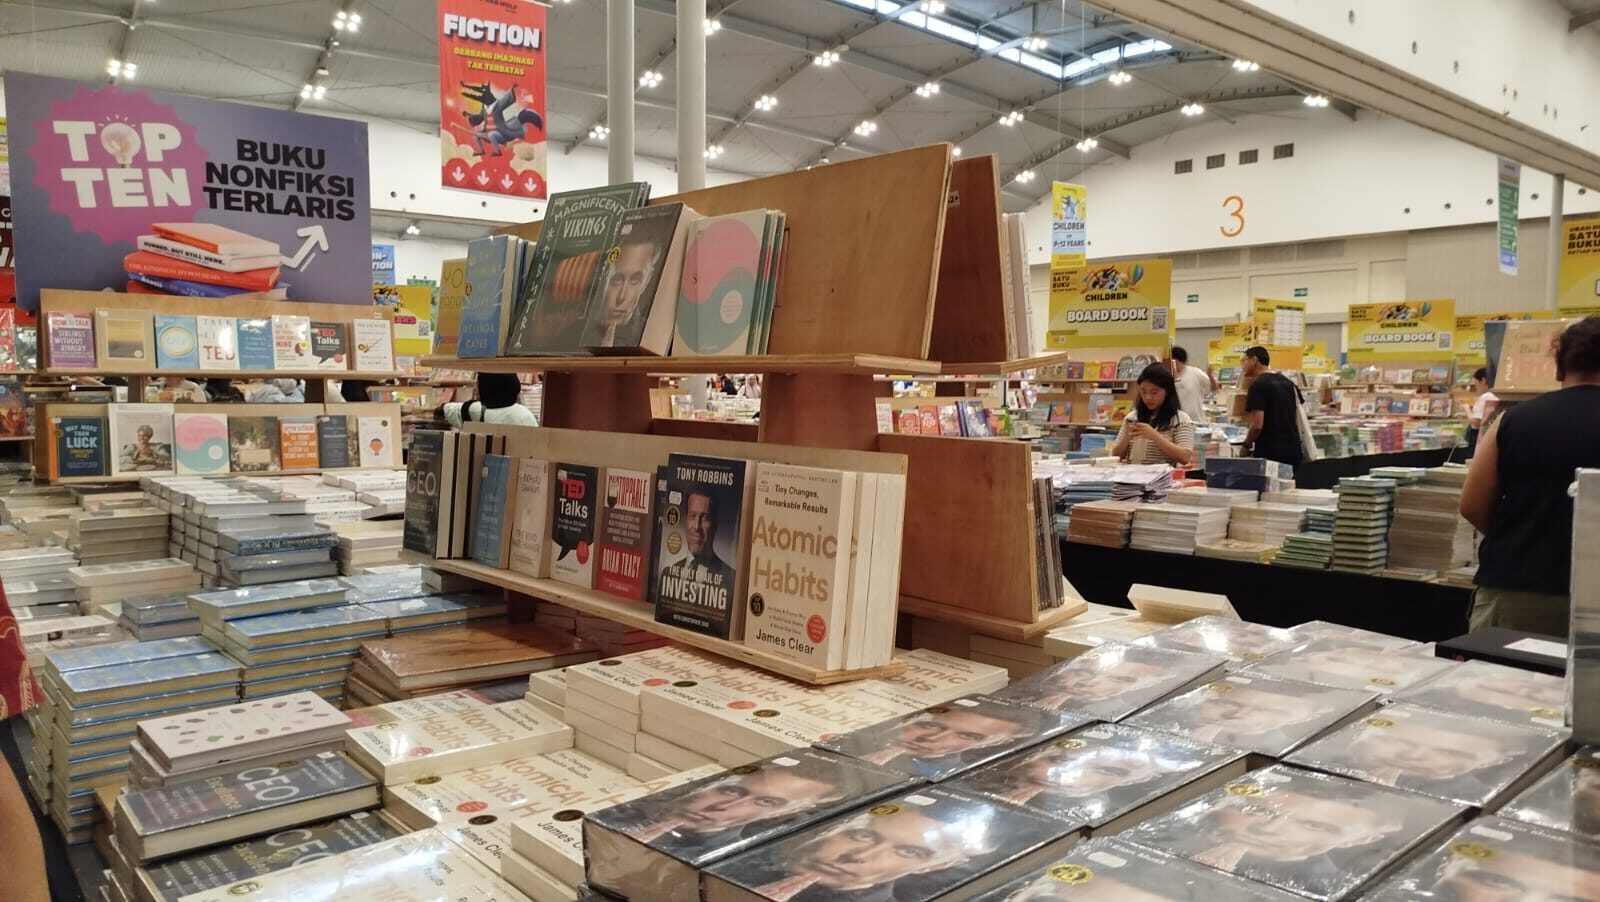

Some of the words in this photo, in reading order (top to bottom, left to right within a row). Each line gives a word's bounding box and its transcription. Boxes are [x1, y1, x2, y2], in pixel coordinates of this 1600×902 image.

[443, 13, 541, 49] FICTION
[53, 120, 182, 162] TOP
[236, 139, 326, 170] BUKU
[60, 167, 192, 208] TEN
[205, 161, 355, 198] NONFIKSI
[202, 186, 356, 221] TERLARIS
[554, 198, 626, 223] MAGNIFICENT
[563, 215, 609, 239] VIKINGS
[1053, 222, 1085, 231] CHILDREN
[1220, 195, 1246, 238] 3
[1567, 240, 1600, 250] BUKU
[1568, 231, 1600, 241] SATU
[1085, 293, 1129, 302] CHILDREN
[1066, 310, 1111, 323] BOARD
[1111, 308, 1148, 320] BOOK
[316, 336, 341, 346] Talks
[1364, 333, 1402, 344] BOARD
[1403, 331, 1435, 342] BOOK
[66, 437, 98, 449] LUCK
[407, 470, 437, 497] CEO
[561, 478, 586, 499] TED
[677, 466, 698, 481] TONY
[697, 469, 735, 486] ROBBINS
[775, 484, 787, 495] Tiny
[788, 486, 819, 499] Changes,
[559, 497, 589, 519] Talks
[764, 497, 801, 510] Remarkable
[801, 502, 829, 515] Results
[752, 515, 838, 561] Atomic
[621, 552, 642, 580] TRACY
[661, 574, 728, 610] INVESTING
[714, 573, 724, 586] OF
[753, 556, 829, 603] Habits
[756, 628, 786, 647] James
[788, 637, 815, 655] Clear
[702, 671, 788, 703] Habits
[884, 673, 938, 692] bits
[906, 664, 969, 685] omic
[420, 714, 471, 749] Habits
[457, 707, 514, 743] Atomic
[745, 716, 783, 734] James
[784, 728, 816, 744] Clear
[236, 766, 300, 801] CEO
[463, 767, 527, 803] Habits
[457, 826, 487, 846] James
[537, 821, 574, 844] James
